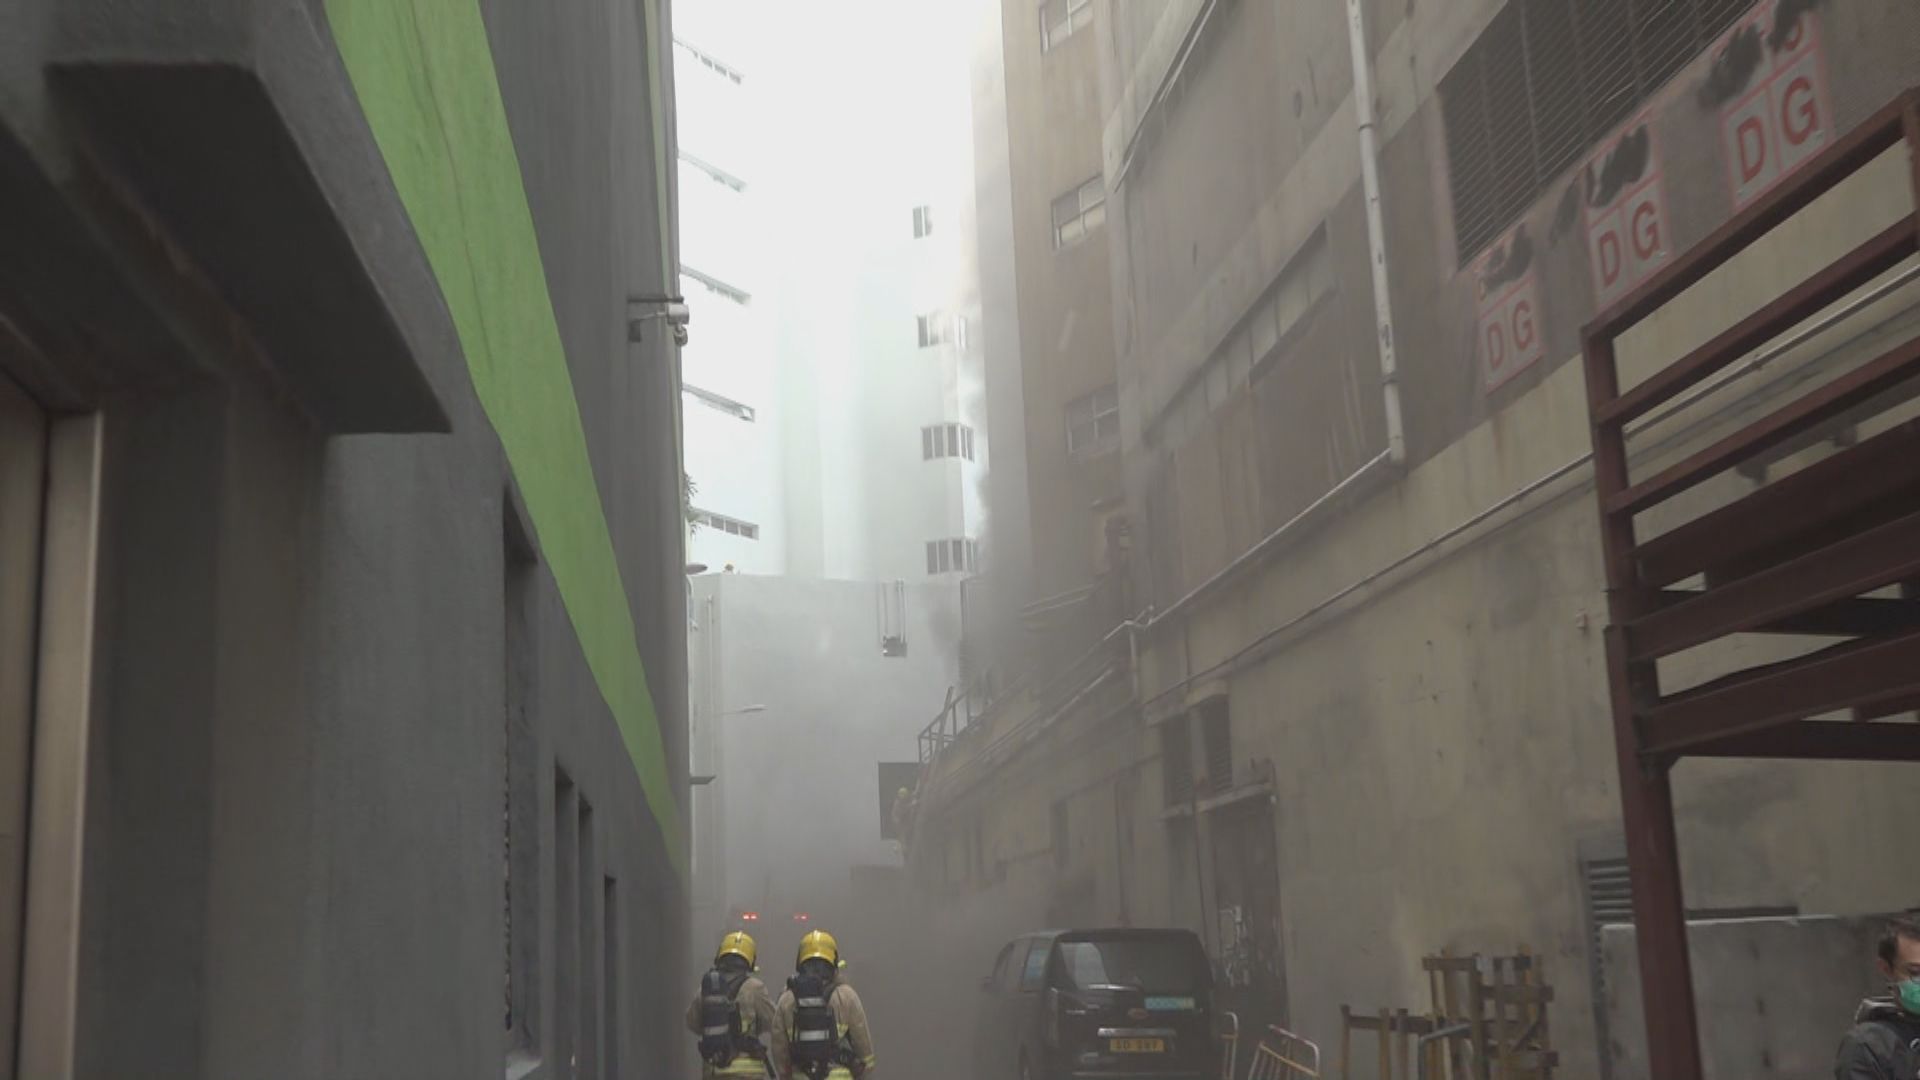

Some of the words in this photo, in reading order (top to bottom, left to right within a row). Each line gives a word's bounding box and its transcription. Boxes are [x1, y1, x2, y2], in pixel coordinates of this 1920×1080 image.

[1737, 76, 1819, 183] DG
[1600, 201, 1661, 286] DG
[1487, 300, 1533, 369] DG
